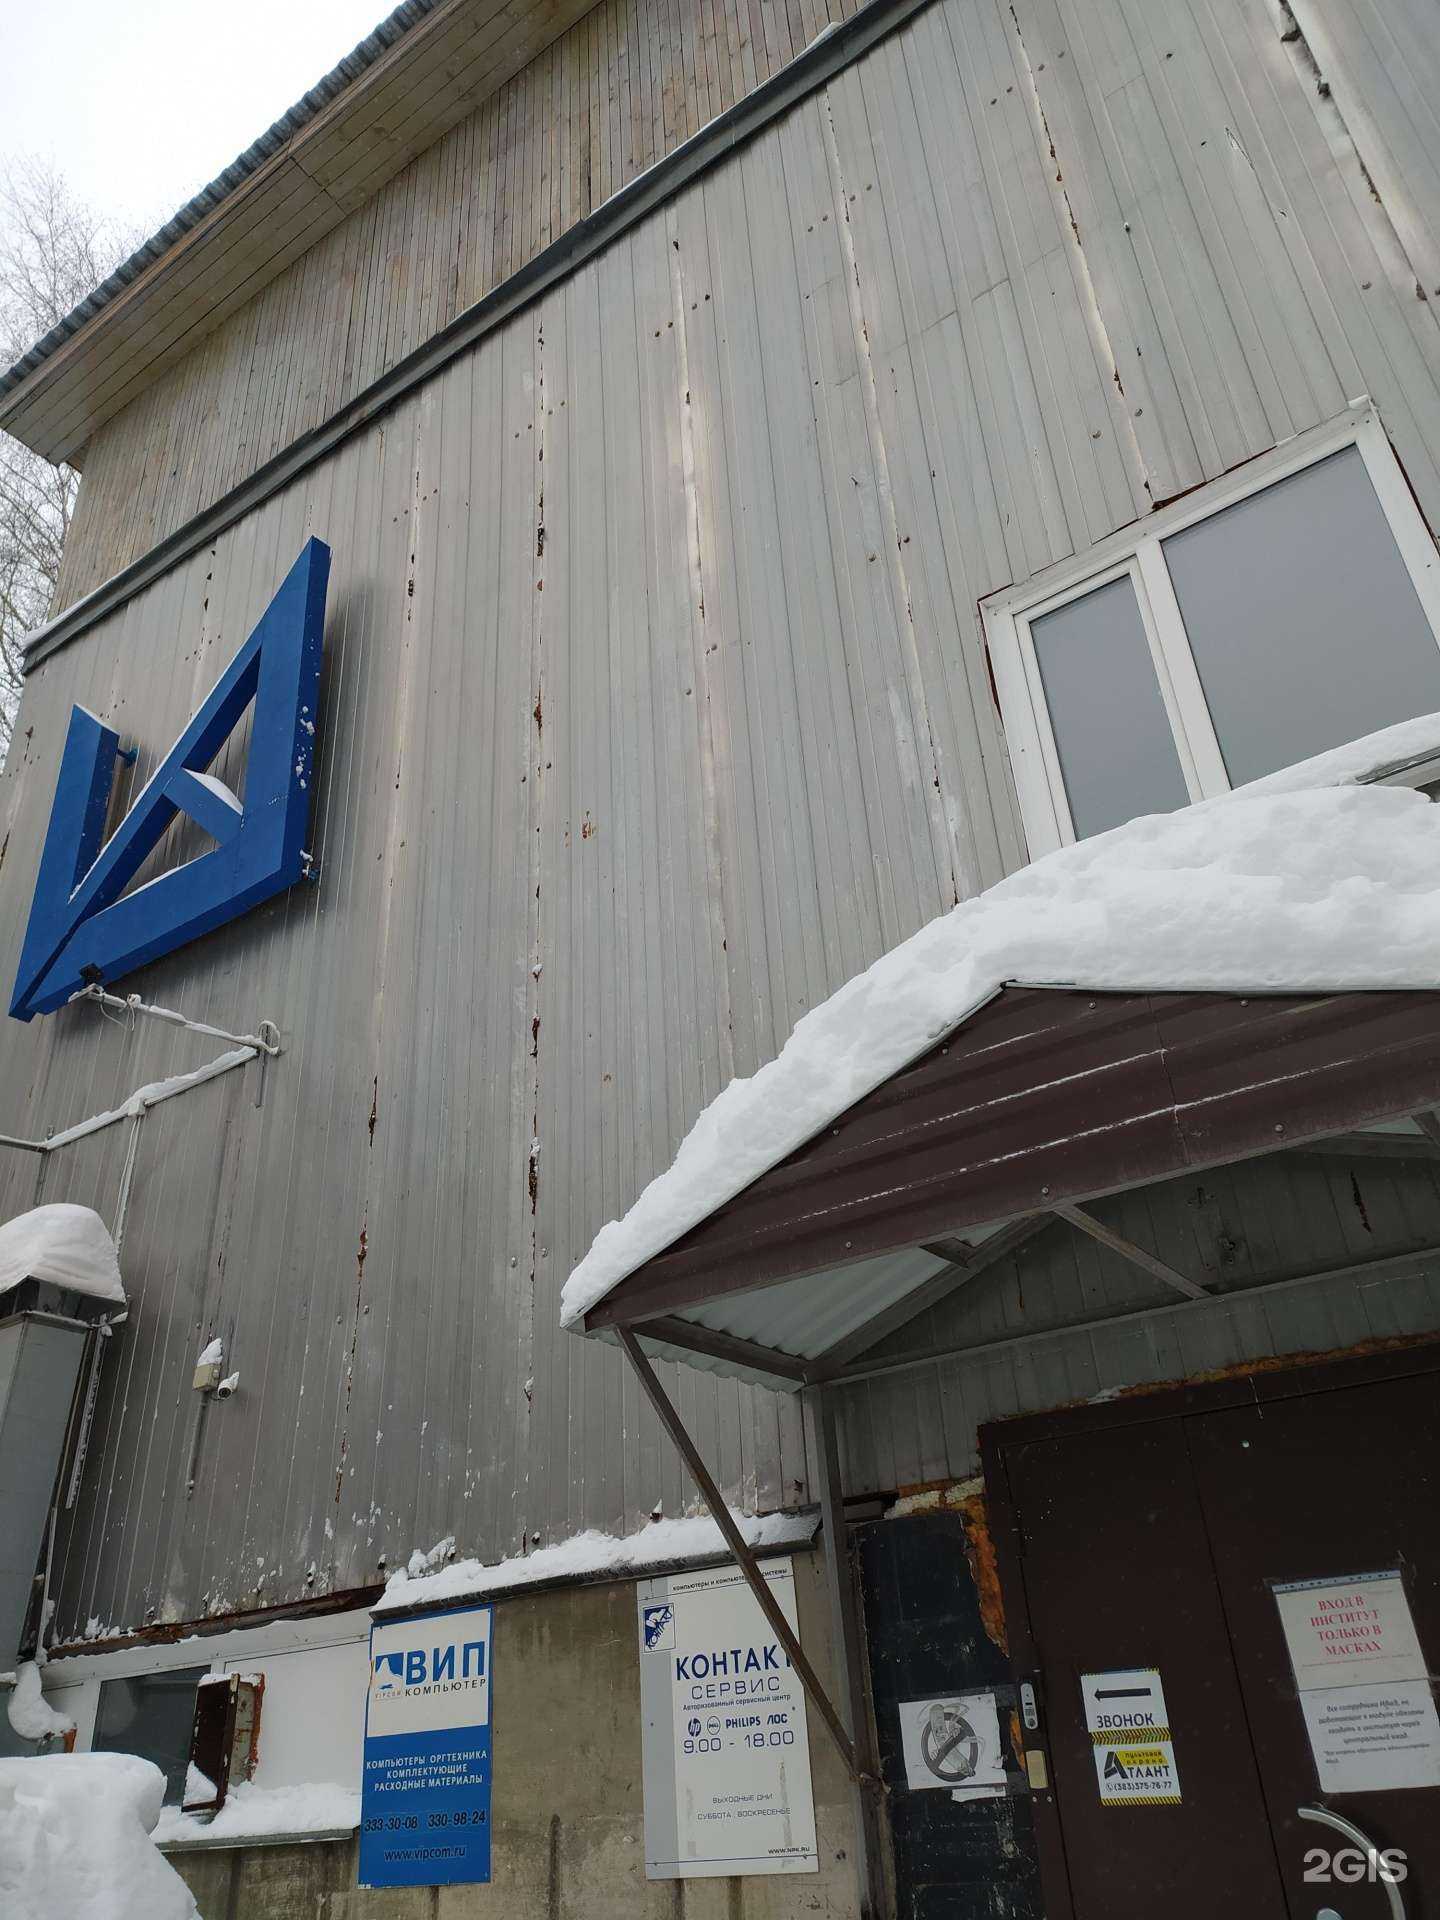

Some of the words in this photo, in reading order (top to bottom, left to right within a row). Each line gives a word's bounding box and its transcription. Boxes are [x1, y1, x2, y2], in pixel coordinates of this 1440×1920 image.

[1310, 1609, 1379, 1627] ИНСТИТУТ
[1317, 1626, 1370, 1641] ТОЛЬКО
[1324, 1640, 1382, 1656] МАСКАХ
[405, 1640, 486, 1686] ВИП
[404, 1678, 487, 1697] КОМПЬЮТЕР
[691, 1676, 780, 1700] СЕРВИС
[772, 1693, 791, 1702] центр
[725, 1715, 762, 1729] PHILIPS
[1096, 1712, 1155, 1728] ЗВОНОК
[683, 1737, 722, 1754] 9.00
[744, 1730, 795, 1750] 18.00
[366, 1756, 426, 1770] КОМПЬЮТЕРЫ
[430, 1750, 487, 1763] ОРГТЕХНИКА
[1104, 1751, 1170, 1779] АТЛАНТ
[387, 1764, 468, 1779] КОМПЛЕКТУЮЩИЕ
[374, 1779, 426, 1792] РАСХОДНЫЕ
[428, 1775, 483, 1789] МАТЕРИАЛЫ
[712, 1794, 754, 1804] ВЫХОДНЫЕ
[757, 1793, 773, 1802] ДНИ
[737, 1807, 792, 1818] ВОСКРЕСЕНЬЕ
[364, 1816, 418, 1832] 333-30-08
[428, 1810, 486, 1827] 330-98-24
[384, 1847, 465, 1861] www.vipcom.ru
